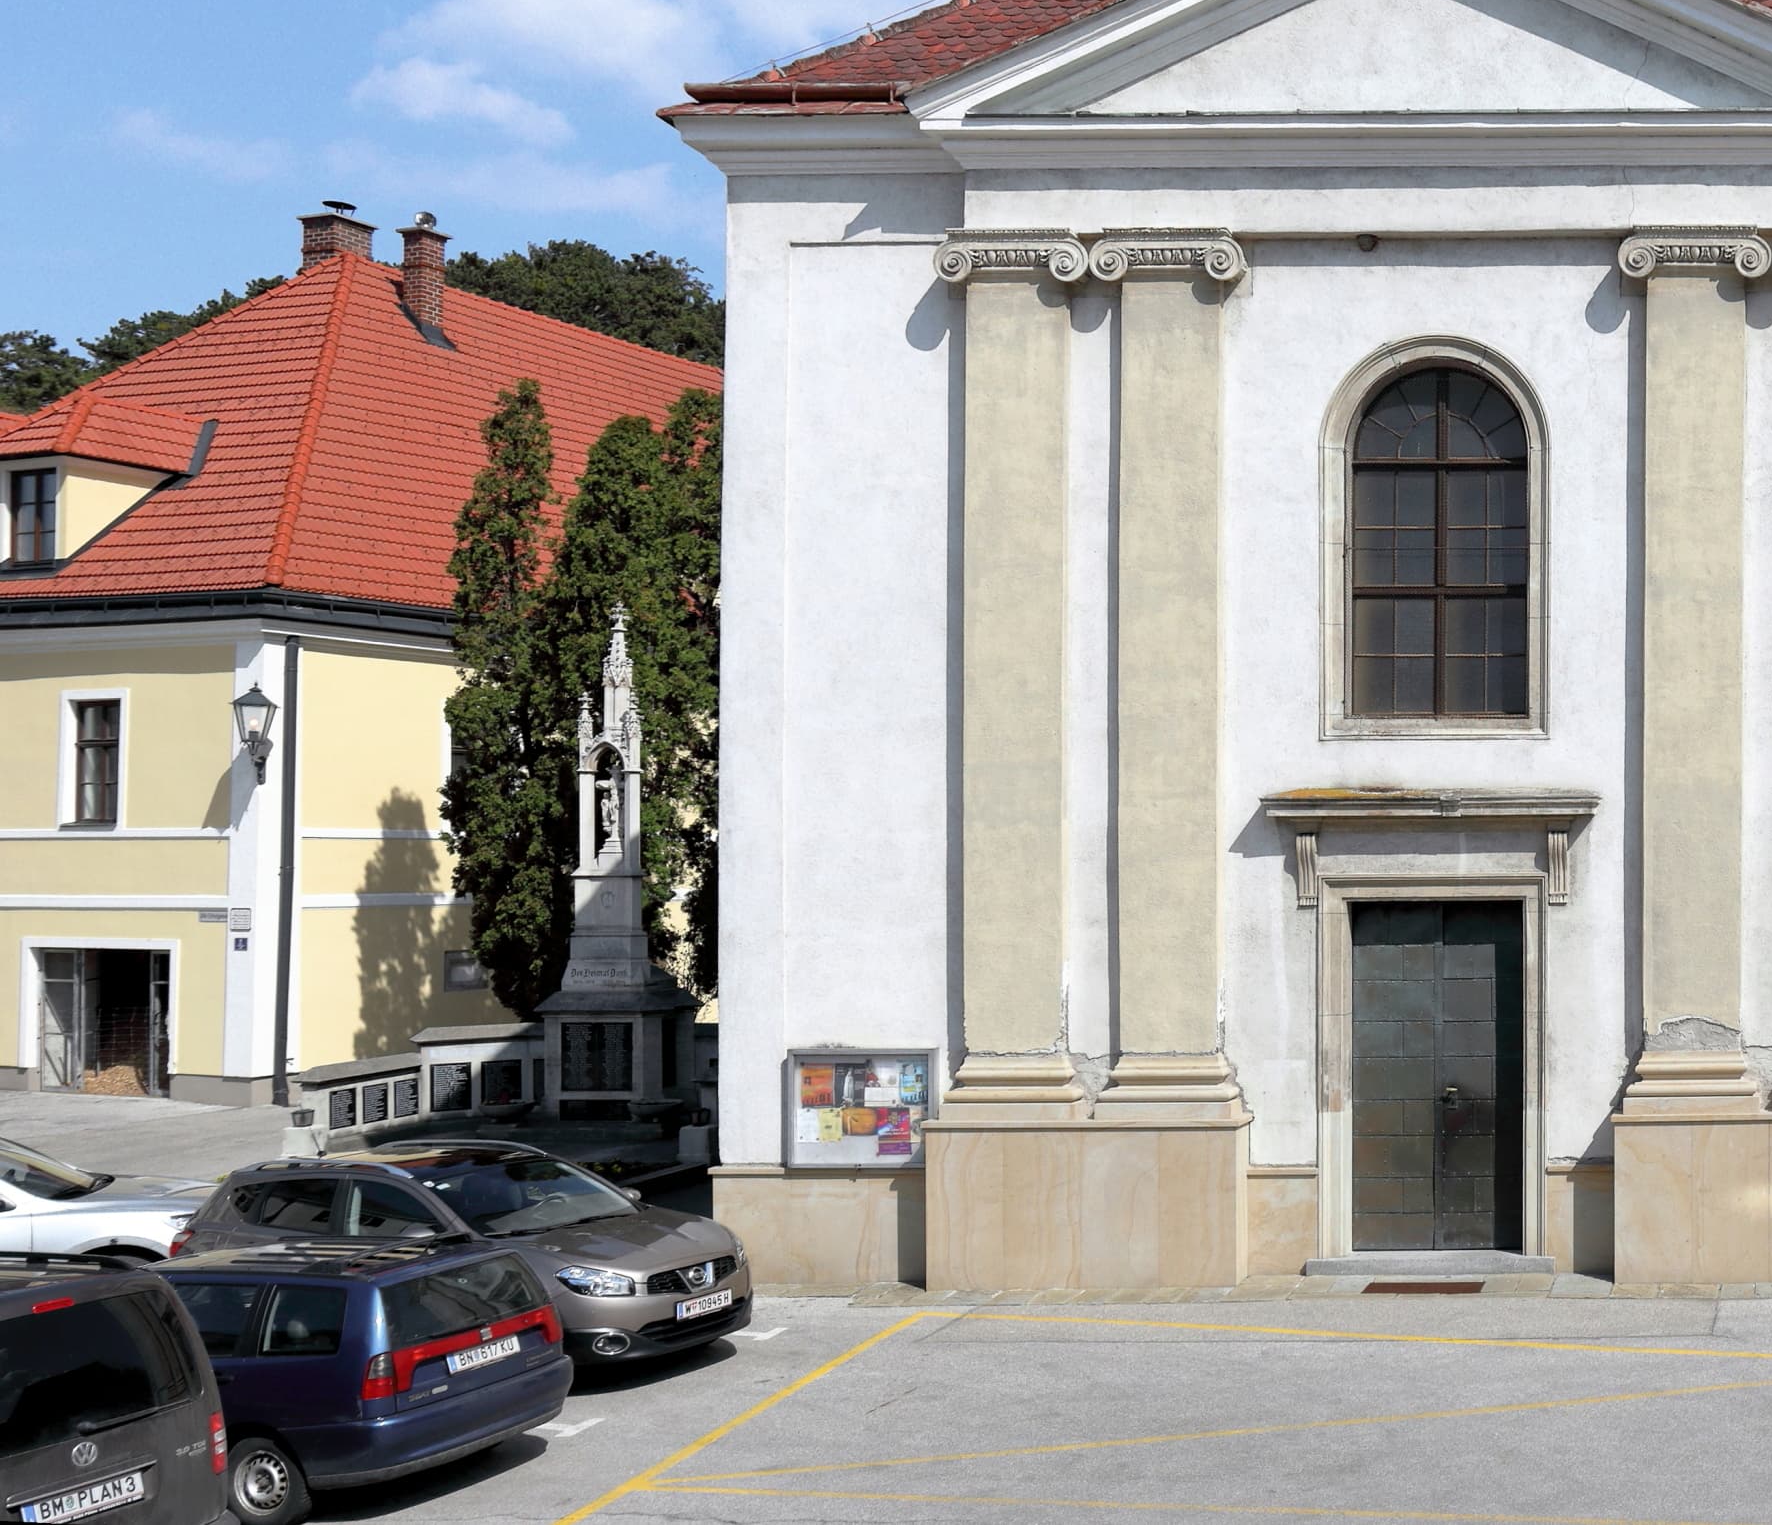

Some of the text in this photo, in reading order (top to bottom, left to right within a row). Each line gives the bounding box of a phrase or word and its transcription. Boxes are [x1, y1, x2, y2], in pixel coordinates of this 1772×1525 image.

[459, 1350, 474, 1367] BN
[480, 1343, 498, 1359] 617
[500, 1337, 514, 1353] KU
[40, 1497, 64, 1520] BM
[77, 1480, 122, 1508] PLAN
[125, 1476, 136, 1492] 3
